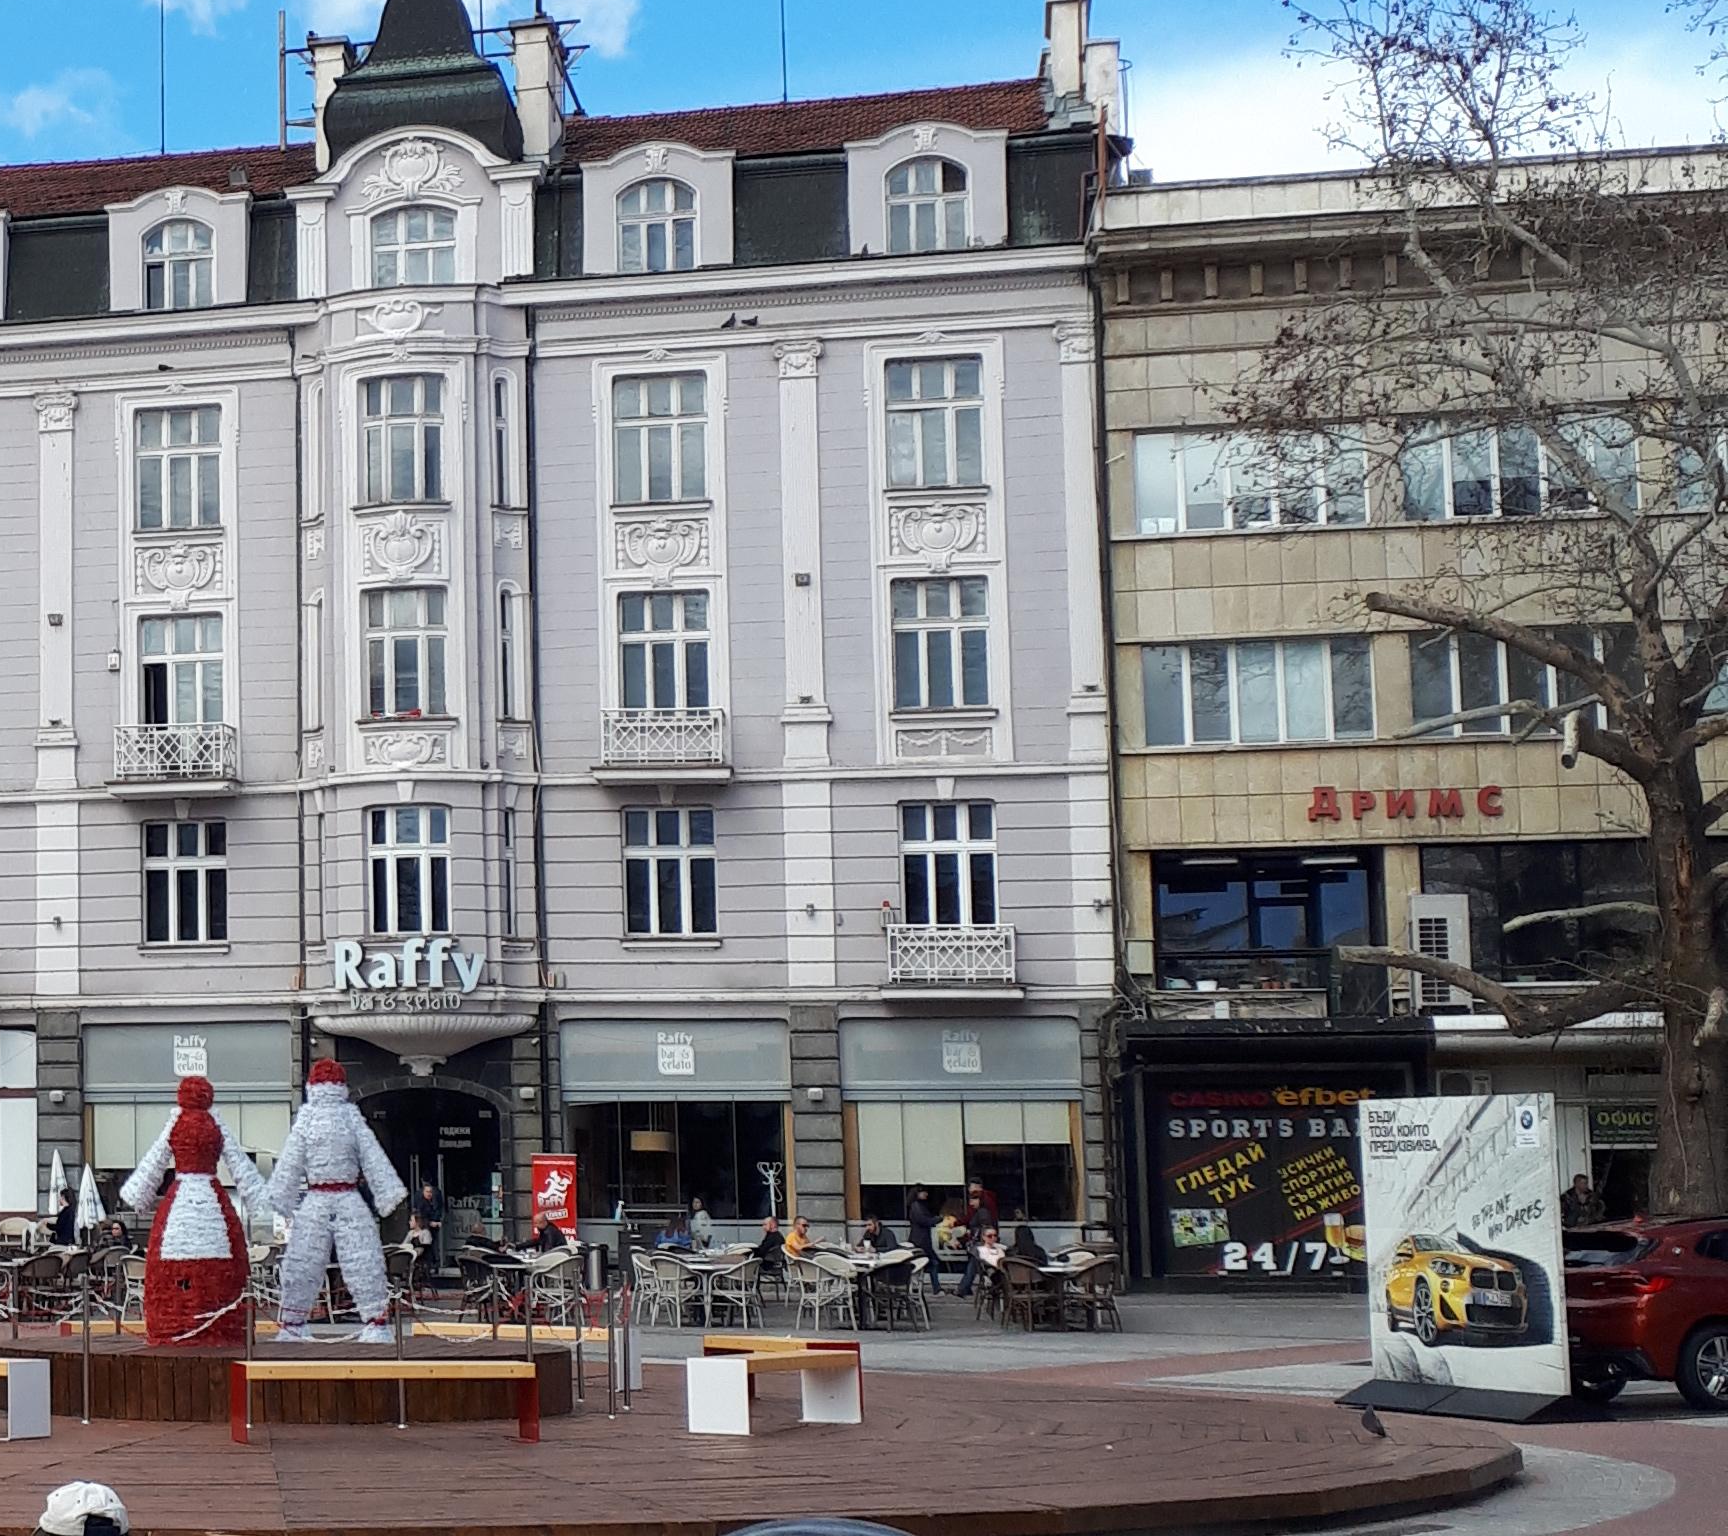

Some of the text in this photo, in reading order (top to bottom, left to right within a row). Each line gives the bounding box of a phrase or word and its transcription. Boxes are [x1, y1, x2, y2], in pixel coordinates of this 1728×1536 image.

[1308, 785, 1504, 822] ДРИМС
[334, 937, 486, 994] Raffy
[350, 990, 376, 1011] bar
[404, 991, 462, 1013] gelato
[174, 1034, 207, 1048] Raffy
[657, 1031, 693, 1046] Raffy
[1170, 1086, 1377, 1107] CASINO efbet
[1168, 1118, 1294, 1138] SPORTS
[1368, 1110, 1396, 1124] БЪДИ
[1597, 1110, 1654, 1126] ОФИС
[1397, 1121, 1429, 1138] КОЙТО
[1175, 1141, 1267, 1194] ГЛЕДАЙ
[1281, 1157, 1349, 1194] СПОРТНИ
[1208, 1174, 1257, 1204] ТУК
[1287, 1170, 1356, 1207] СЪБИТИЯ
[447, 1195, 480, 1209] Raffy
[1293, 1184, 1361, 1222] НА ЖИВО
[1223, 1241, 1327, 1275] 24/7
